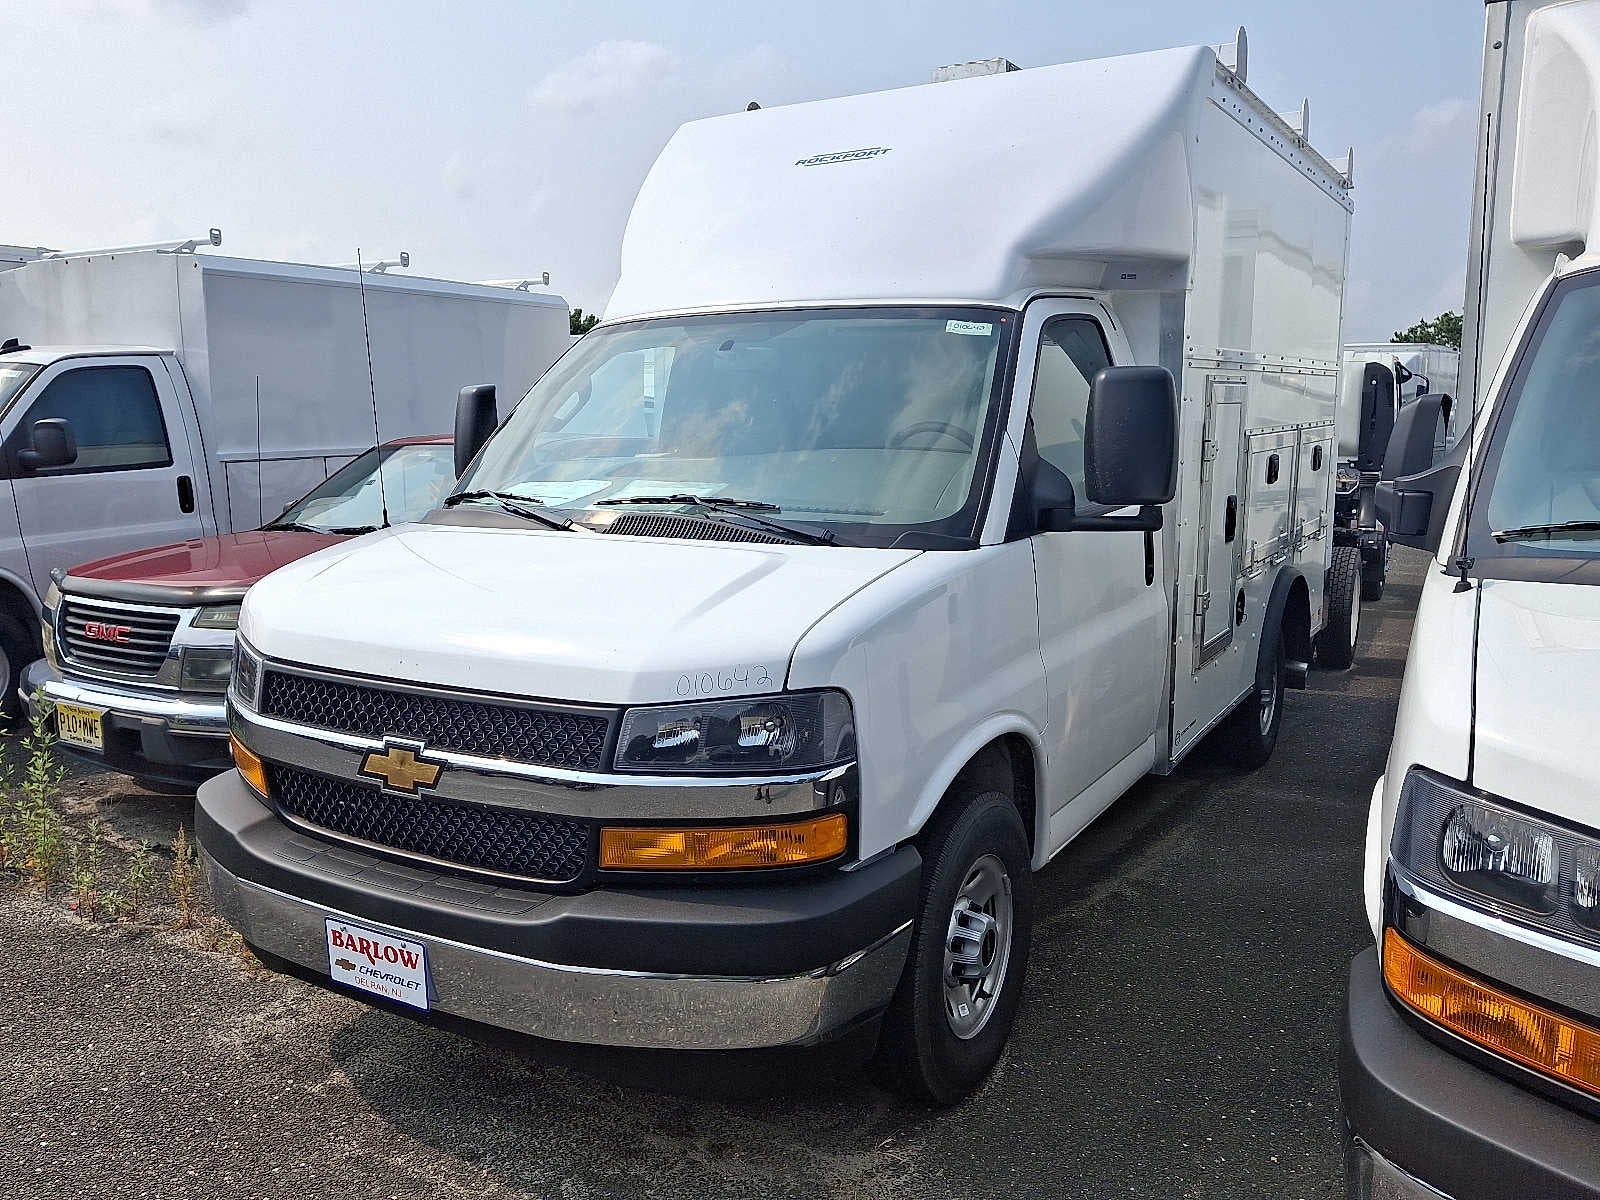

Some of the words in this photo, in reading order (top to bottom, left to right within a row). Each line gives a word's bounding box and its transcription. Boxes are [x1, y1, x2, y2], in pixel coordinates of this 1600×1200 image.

[795, 147, 893, 166] ROCKPORT
[84, 621, 131, 643] GMC
[676, 664, 773, 696] 010642
[331, 929, 420, 970] BARLOW
[354, 975, 390, 995] DELRAN,
[391, 987, 402, 998] NJ
[358, 965, 422, 990] CHEVROLET
